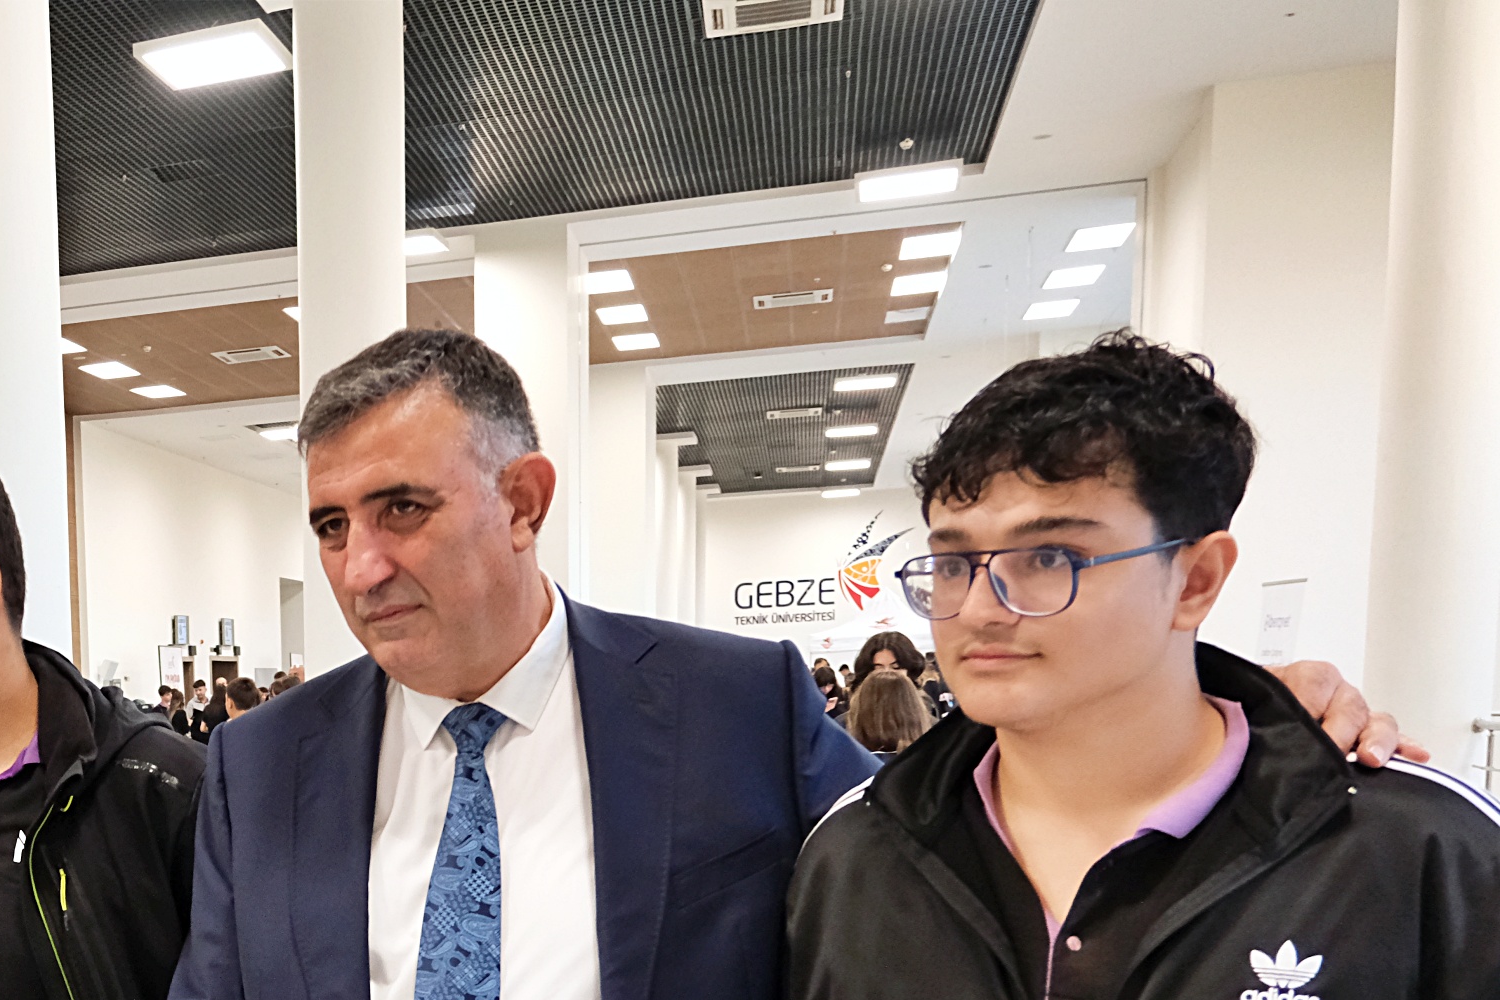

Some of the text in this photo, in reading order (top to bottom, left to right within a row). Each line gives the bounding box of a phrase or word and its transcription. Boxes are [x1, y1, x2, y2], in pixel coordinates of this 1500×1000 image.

[734, 577, 835, 609] GEBZE
[734, 609, 836, 626] TEKNİK ÜNİVERSİTESİ
